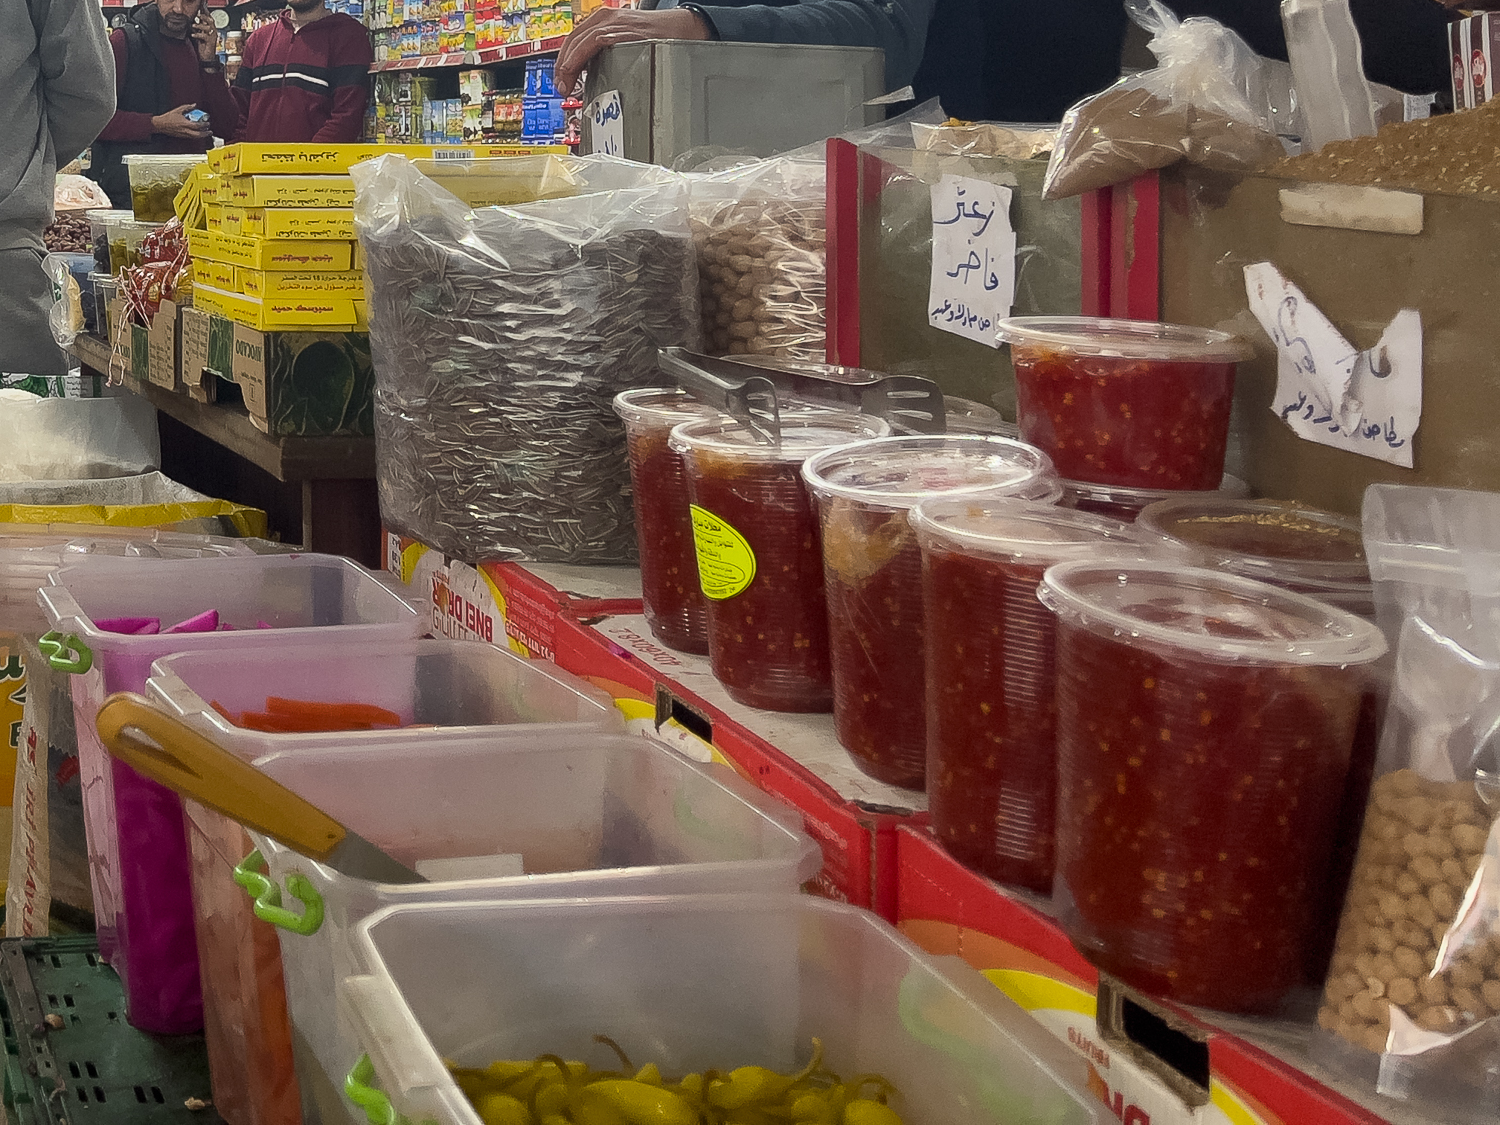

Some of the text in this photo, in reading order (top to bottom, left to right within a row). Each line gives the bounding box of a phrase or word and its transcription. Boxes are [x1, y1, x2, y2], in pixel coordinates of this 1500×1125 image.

[261, 153, 296, 164] تحفظ
[933, 186, 994, 237] زعتر
[466, 600, 493, 643] BNEI
